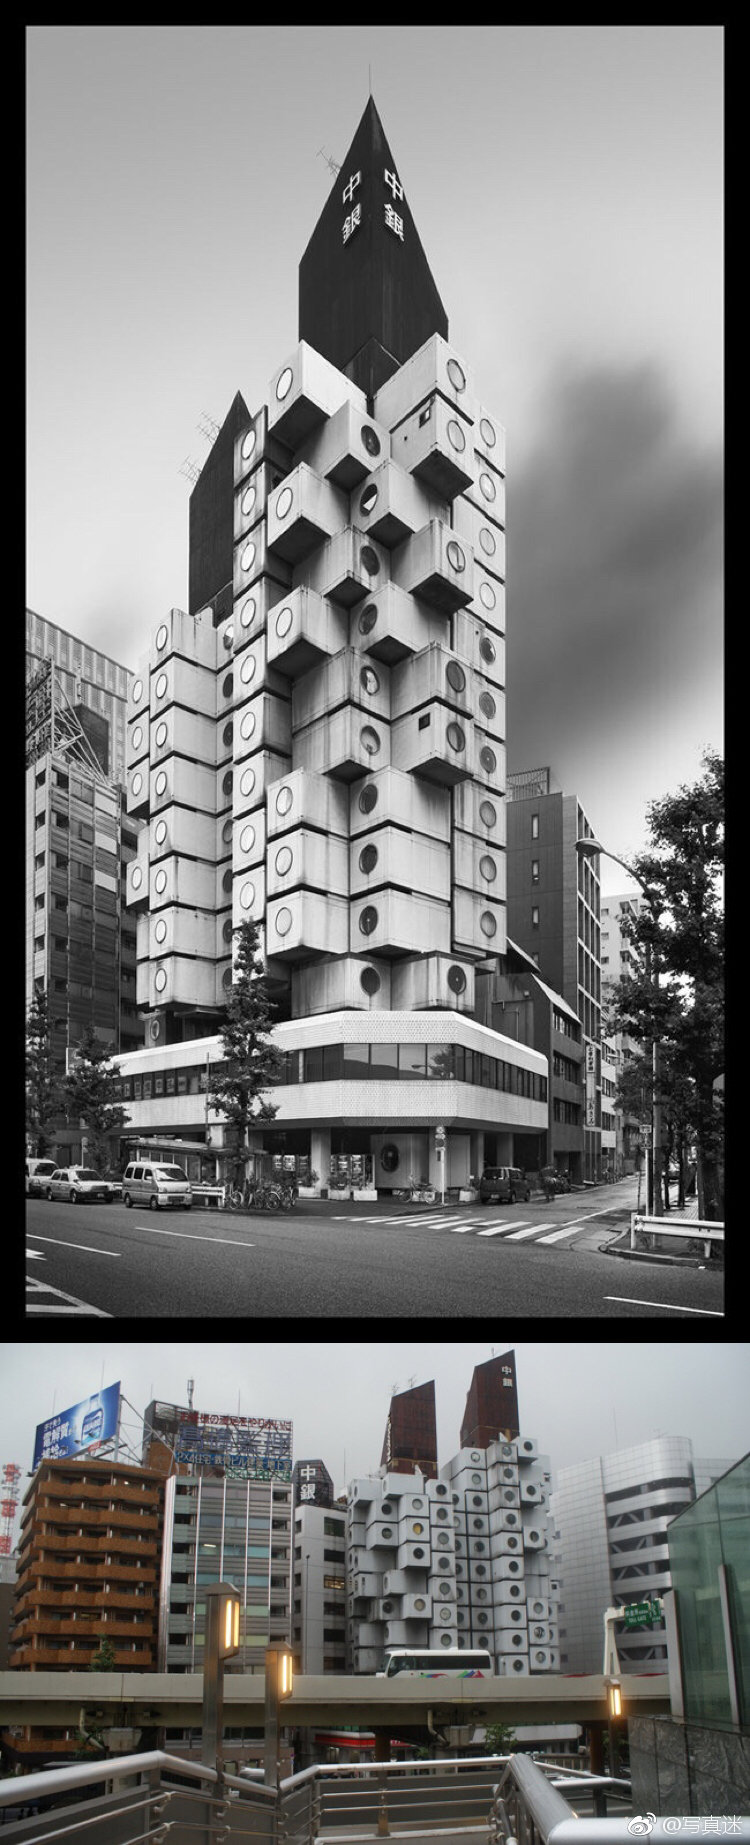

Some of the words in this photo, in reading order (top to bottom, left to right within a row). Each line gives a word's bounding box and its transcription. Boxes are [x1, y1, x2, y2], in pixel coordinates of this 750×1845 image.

[342, 170, 361, 245] 中銀
[384, 168, 404, 242] 中銀
[300, 1465, 316, 1501] 中銀
